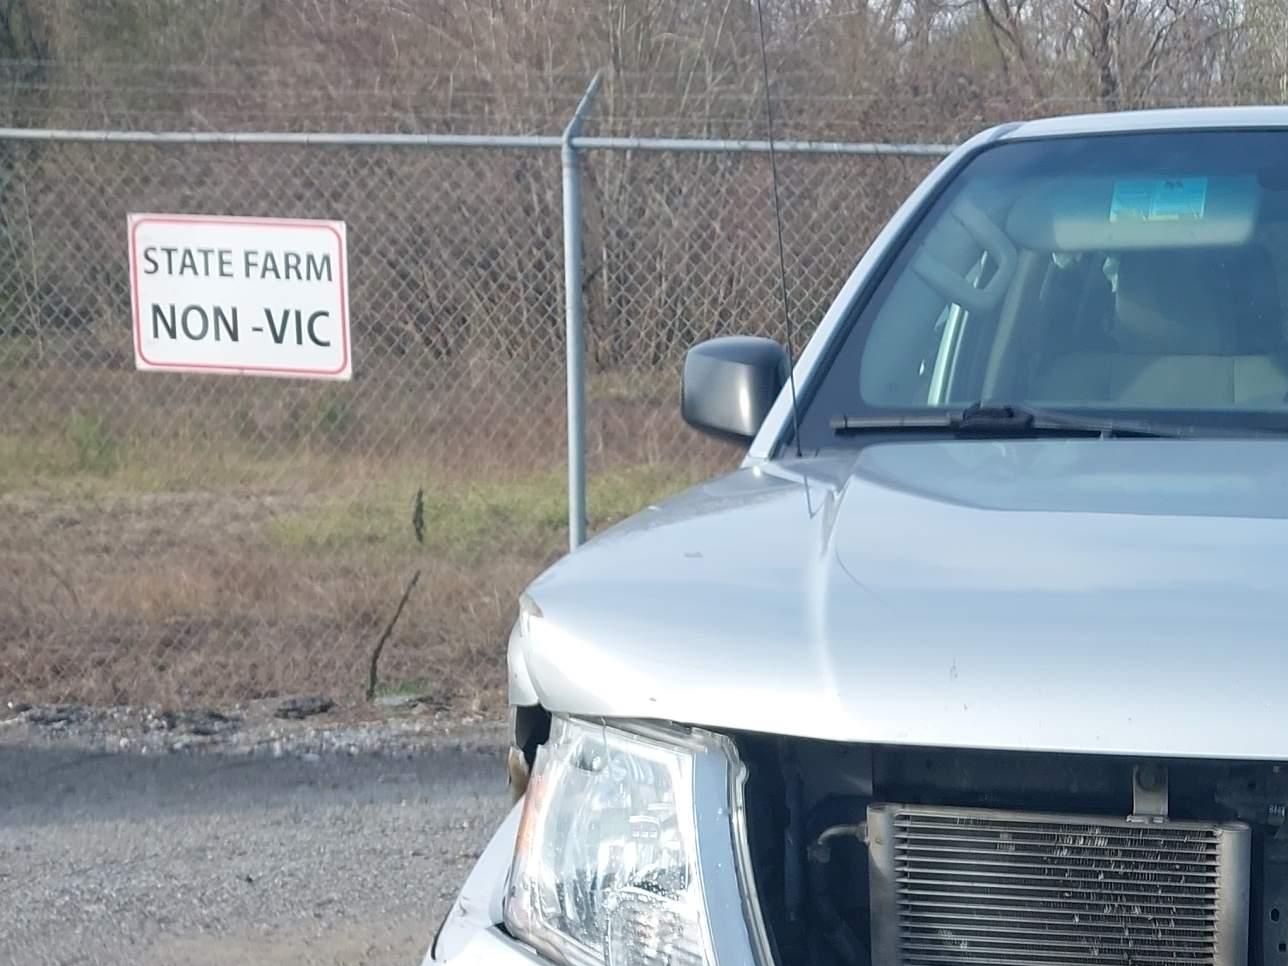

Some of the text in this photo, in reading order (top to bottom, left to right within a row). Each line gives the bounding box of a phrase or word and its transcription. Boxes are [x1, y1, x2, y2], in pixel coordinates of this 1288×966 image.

[143, 246, 334, 282] STATE FARM
[151, 303, 240, 343] NON
